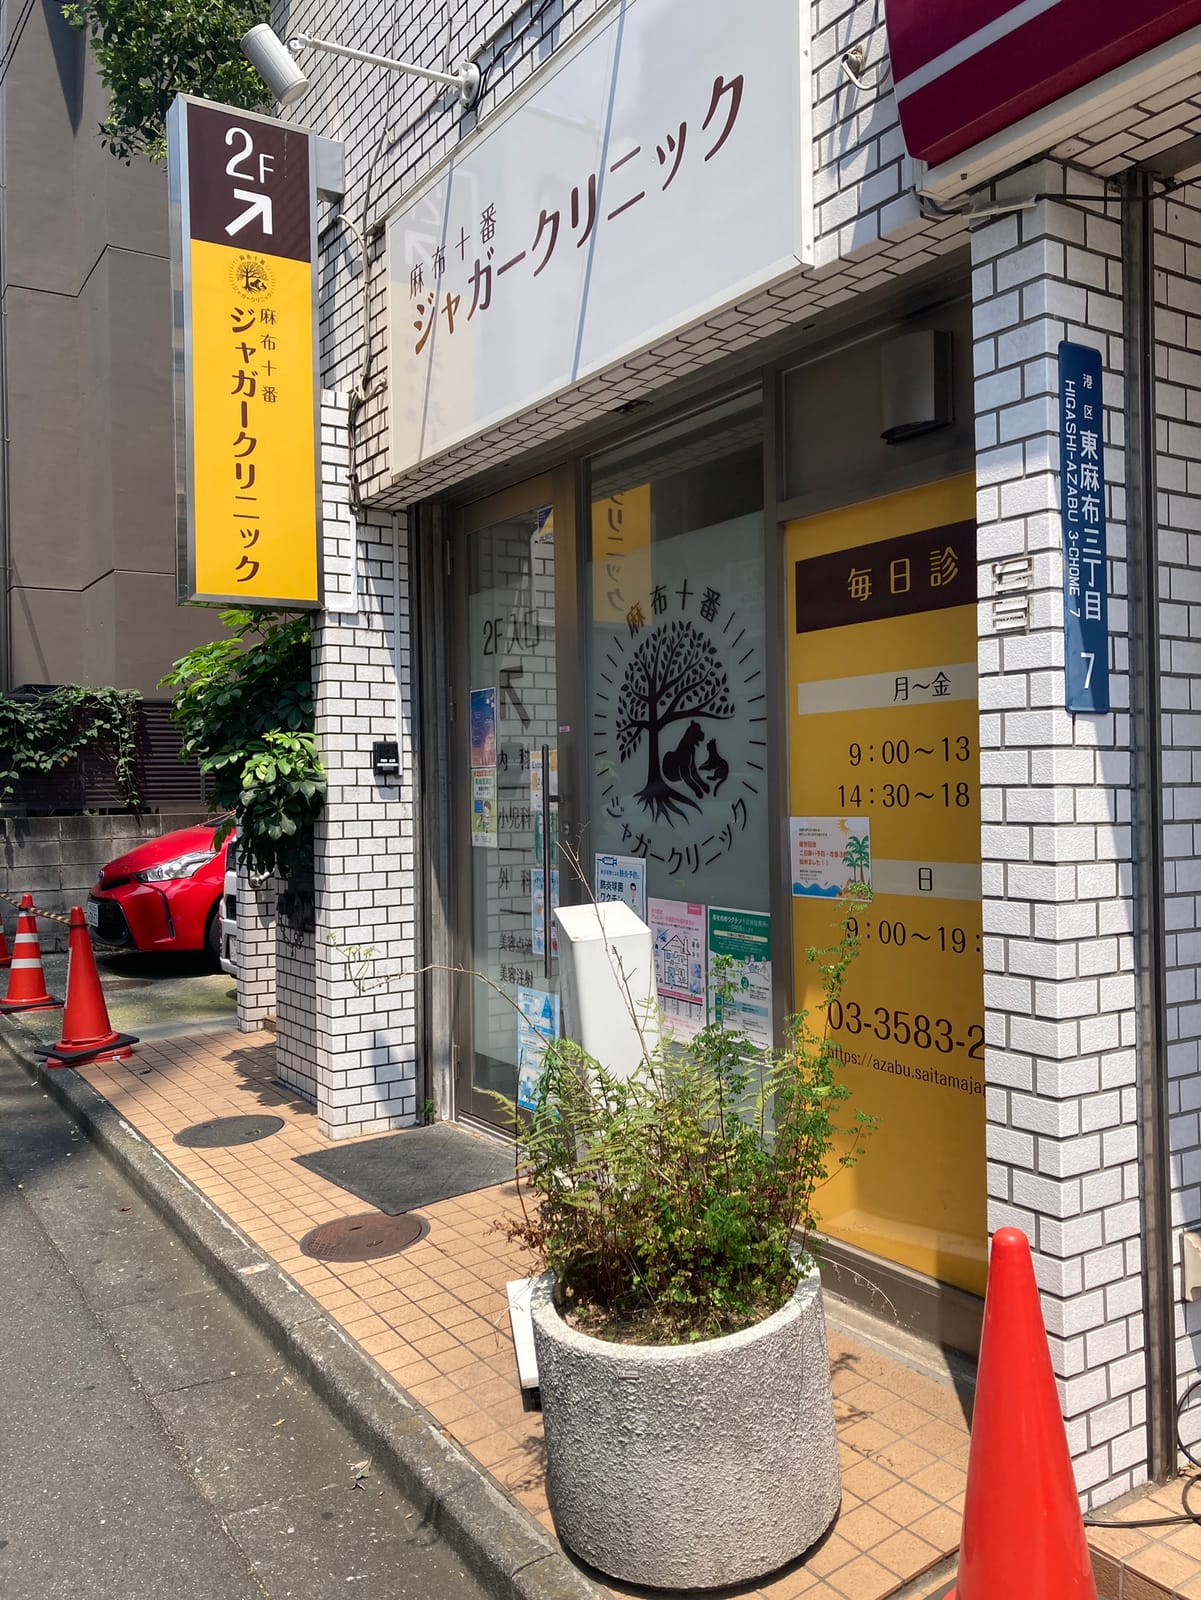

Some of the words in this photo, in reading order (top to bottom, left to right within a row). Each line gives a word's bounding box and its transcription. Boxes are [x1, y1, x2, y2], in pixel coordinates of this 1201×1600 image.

[224, 126, 275, 184] 2F
[412, 73, 745, 356] ジャガークリニック
[408, 202, 497, 300] 麻布十番
[259, 307, 278, 404] 麻布十番
[1082, 373, 1095, 420] 港区
[229, 306, 260, 583] ジャガークリニック
[1064, 379, 1079, 523] HIGASHI-AZABU
[1079, 429, 1102, 621] 東麻布三丁目
[847, 545, 960, 602] 毎日診
[1067, 530, 1081, 597] 3-CHOME
[483, 609, 540, 656] 2F入口
[626, 578, 721, 640] 麻布十番
[1069, 607, 1081, 618] 7
[893, 670, 952, 702] 月～金
[1080, 652, 1096, 689] 7
[498, 805, 532, 831] 小児科
[606, 795, 748, 875] ジャガークリニック
[498, 867, 532, 893] 外科
[918, 867, 933, 892] 日
